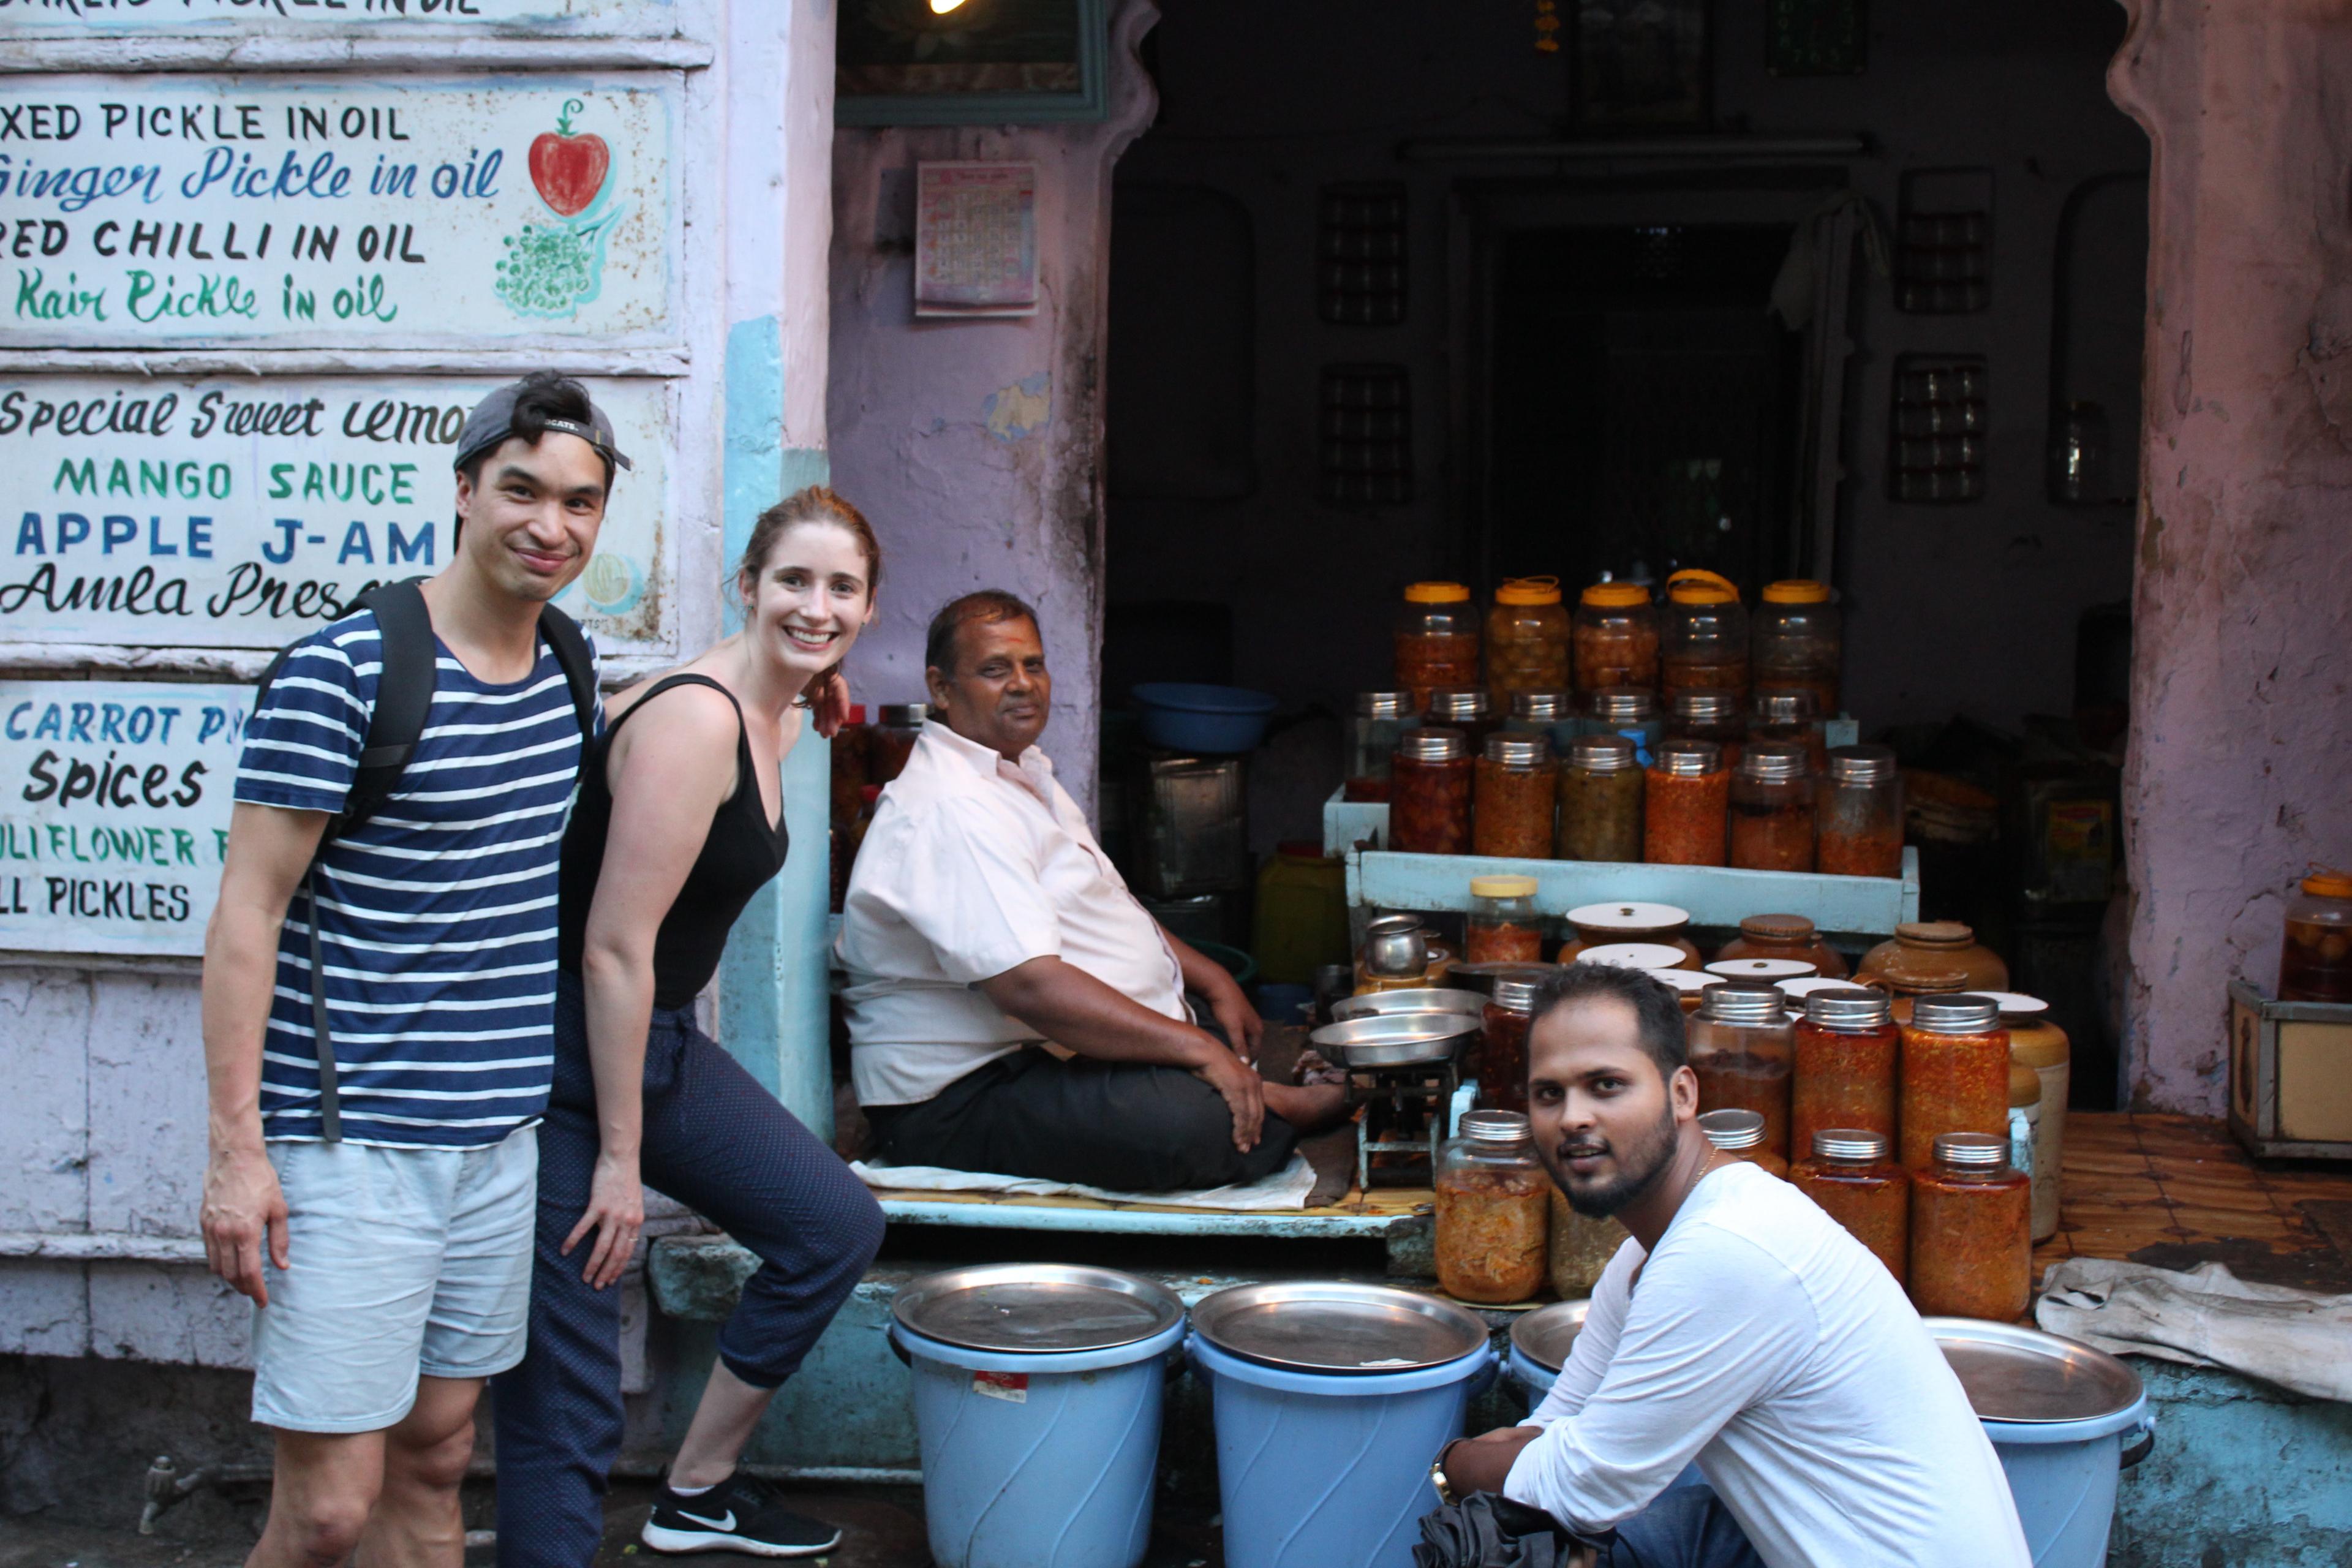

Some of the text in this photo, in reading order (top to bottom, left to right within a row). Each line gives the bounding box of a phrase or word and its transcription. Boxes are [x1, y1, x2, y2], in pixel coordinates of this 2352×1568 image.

[0, 103, 410, 141] XED PICKLE IN OIL
[180, 146, 352, 200] Pickle
[370, 154, 418, 198] in
[431, 148, 504, 199] oil
[92, 218, 273, 260] CHILLI
[292, 224, 339, 263] IN
[357, 223, 426, 263] OIL
[333, 273, 398, 322] oil
[0, 391, 476, 445] Special Sweet Lemo
[53, 457, 418, 506] MANGO SAUCE
[15, 511, 213, 559] APPLE
[206, 562, 392, 621] Pres
[6, 701, 181, 745] CARROT
[22, 749, 209, 809] Spices
[0, 823, 197, 867] LIFLOWER
[45, 876, 190, 922] PICKLES
